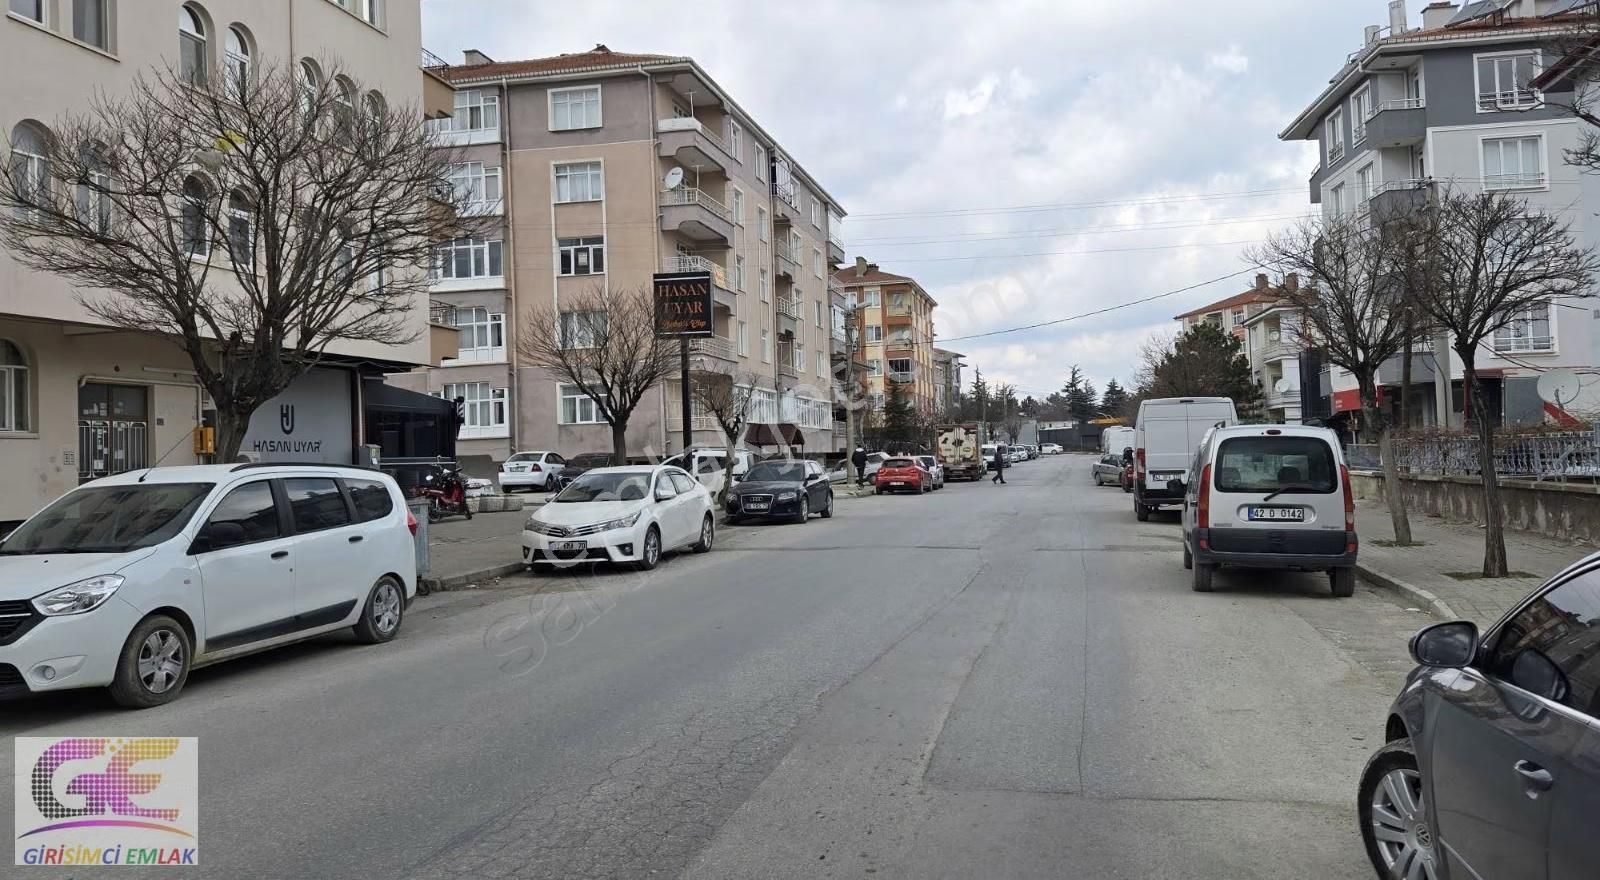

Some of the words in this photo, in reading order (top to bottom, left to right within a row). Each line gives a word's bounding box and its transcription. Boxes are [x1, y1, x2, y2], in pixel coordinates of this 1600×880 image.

[659, 282, 707, 297] HASAN
[664, 301, 703, 314] UYAR
[253, 440, 291, 453] HASAN
[294, 440, 320, 453] UYAR
[1254, 509, 1265, 518] 42
[1280, 509, 1302, 518] 0142
